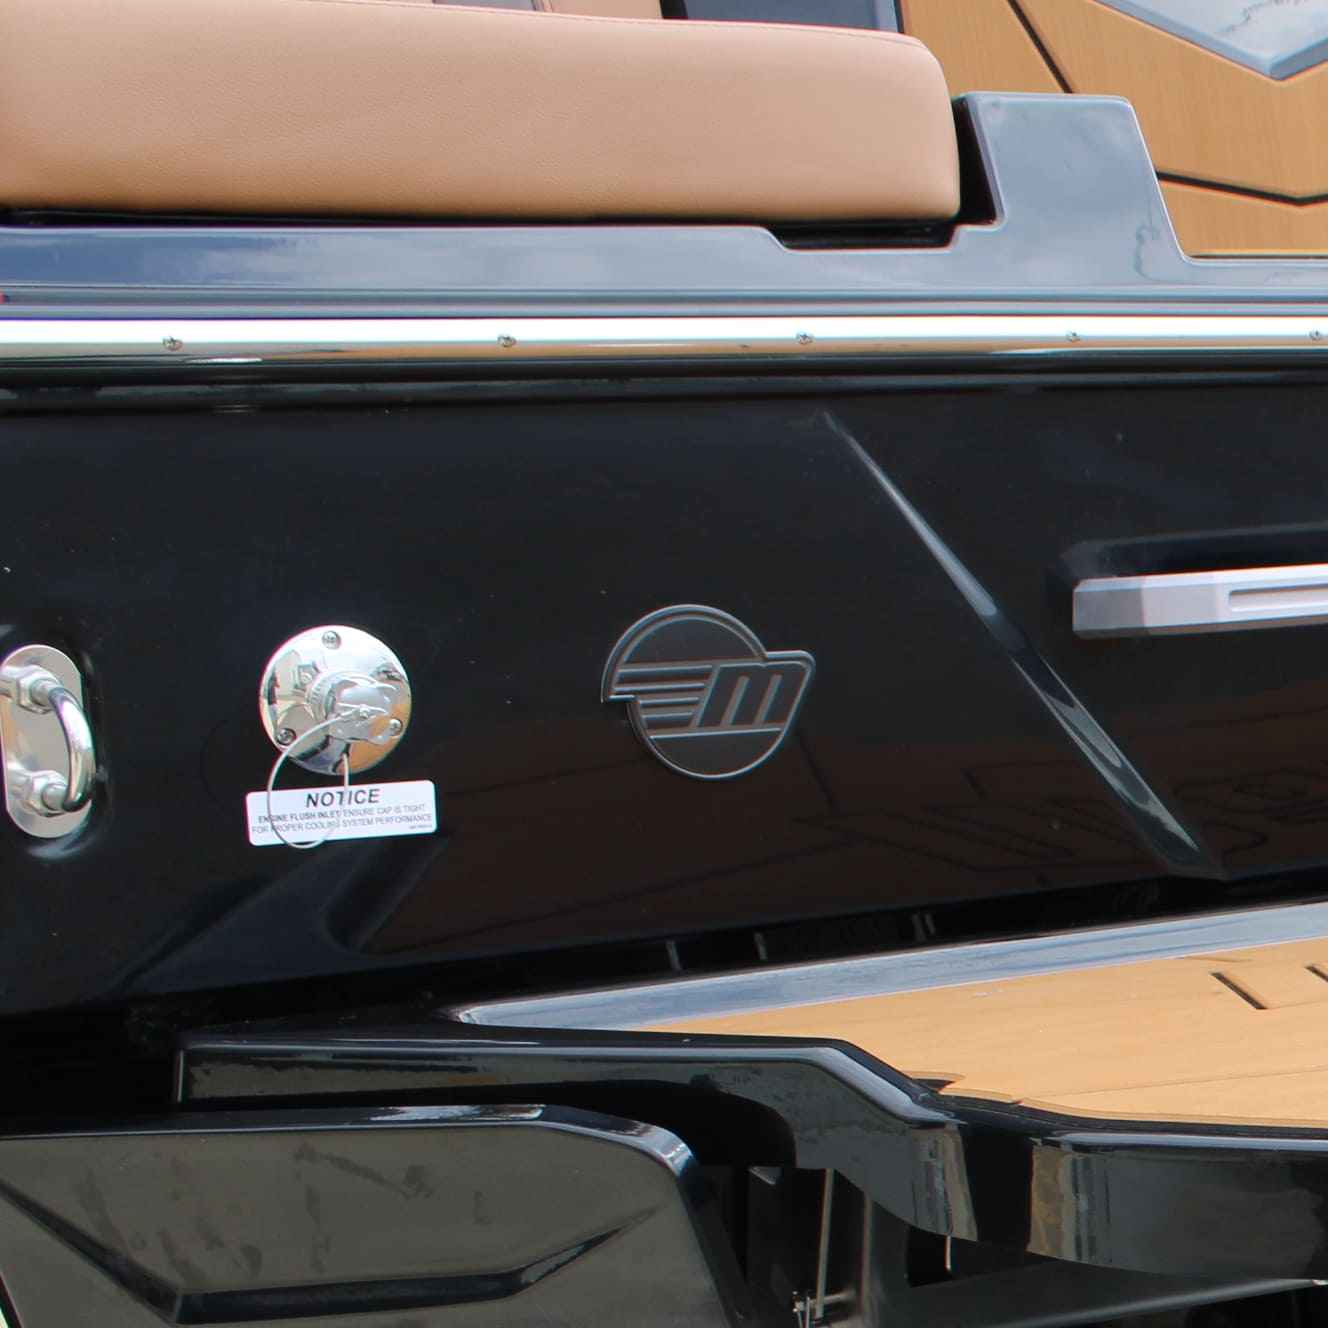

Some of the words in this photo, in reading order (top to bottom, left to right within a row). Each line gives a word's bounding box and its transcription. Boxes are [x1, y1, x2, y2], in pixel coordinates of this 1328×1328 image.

[305, 789, 381, 808] NOTICE
[290, 811, 316, 822] FLUSH
[377, 805, 392, 815] CAP
[251, 824, 269, 834] FOR
[342, 818, 374, 829] SYSTEM
[375, 814, 432, 826] PERFORMANCE
